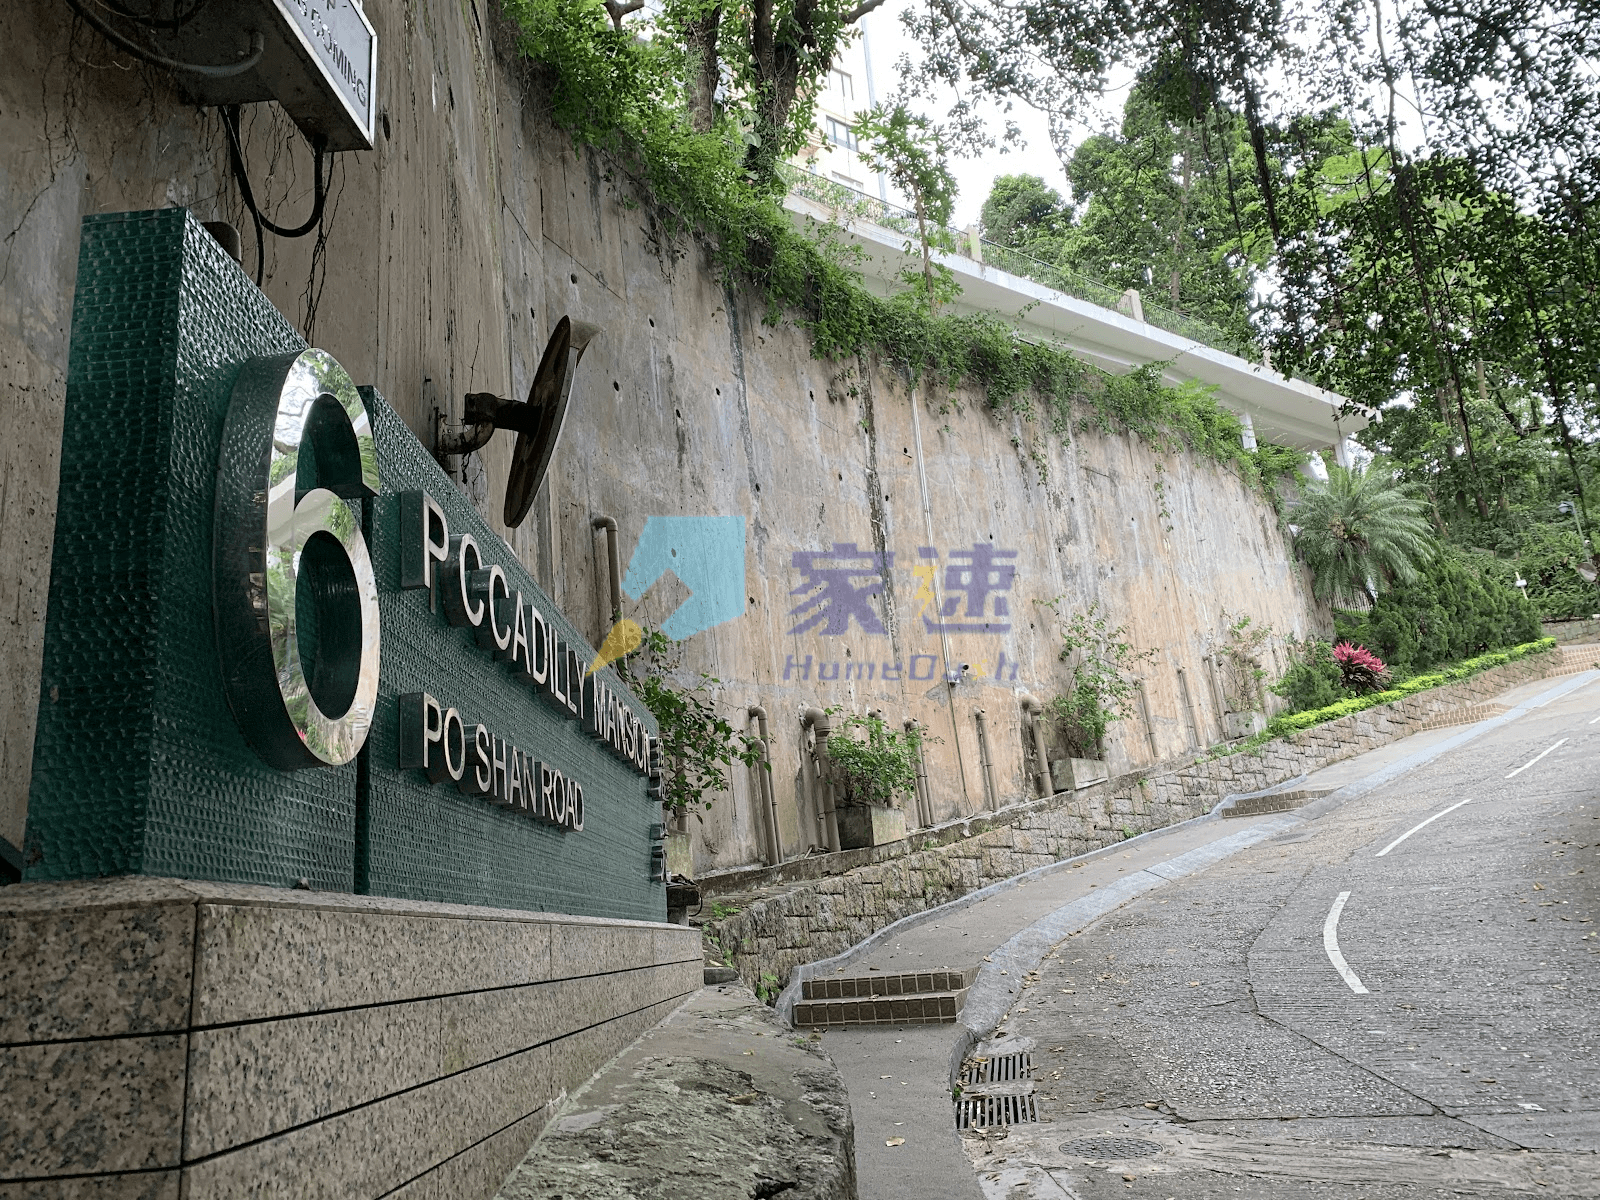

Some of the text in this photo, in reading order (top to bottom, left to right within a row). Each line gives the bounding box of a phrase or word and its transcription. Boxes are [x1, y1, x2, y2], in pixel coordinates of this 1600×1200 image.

[310, 8, 367, 107] COMING
[267, 348, 380, 766] 6
[423, 691, 466, 781] PO
[475, 723, 537, 814] SHAN
[541, 761, 585, 832] ROAD
[592, 670, 652, 777] MANSION
